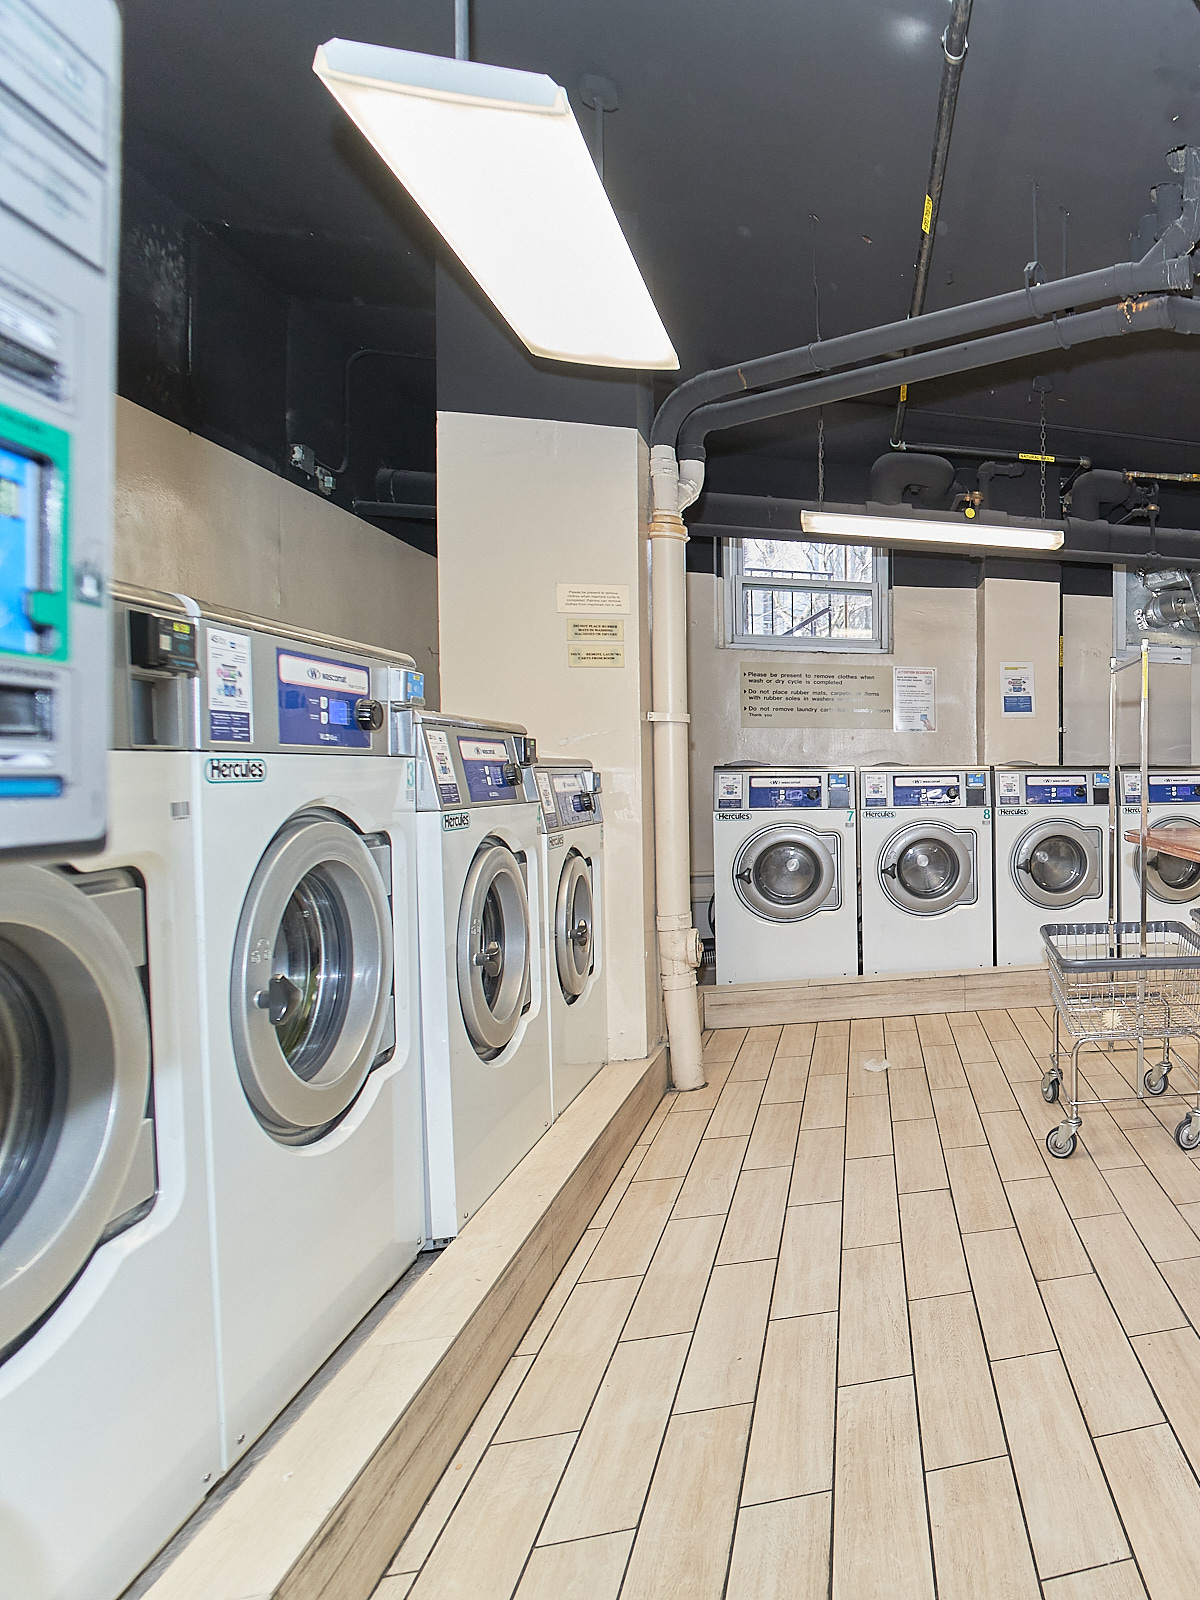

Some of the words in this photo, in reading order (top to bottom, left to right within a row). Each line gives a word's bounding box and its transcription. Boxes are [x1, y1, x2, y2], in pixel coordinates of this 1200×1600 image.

[211, 758, 264, 778] Hercules
[406, 761, 414, 787] 3
[444, 813, 469, 828] Hercules
[846, 811, 854, 821] 7
[984, 809, 990, 819] 8
